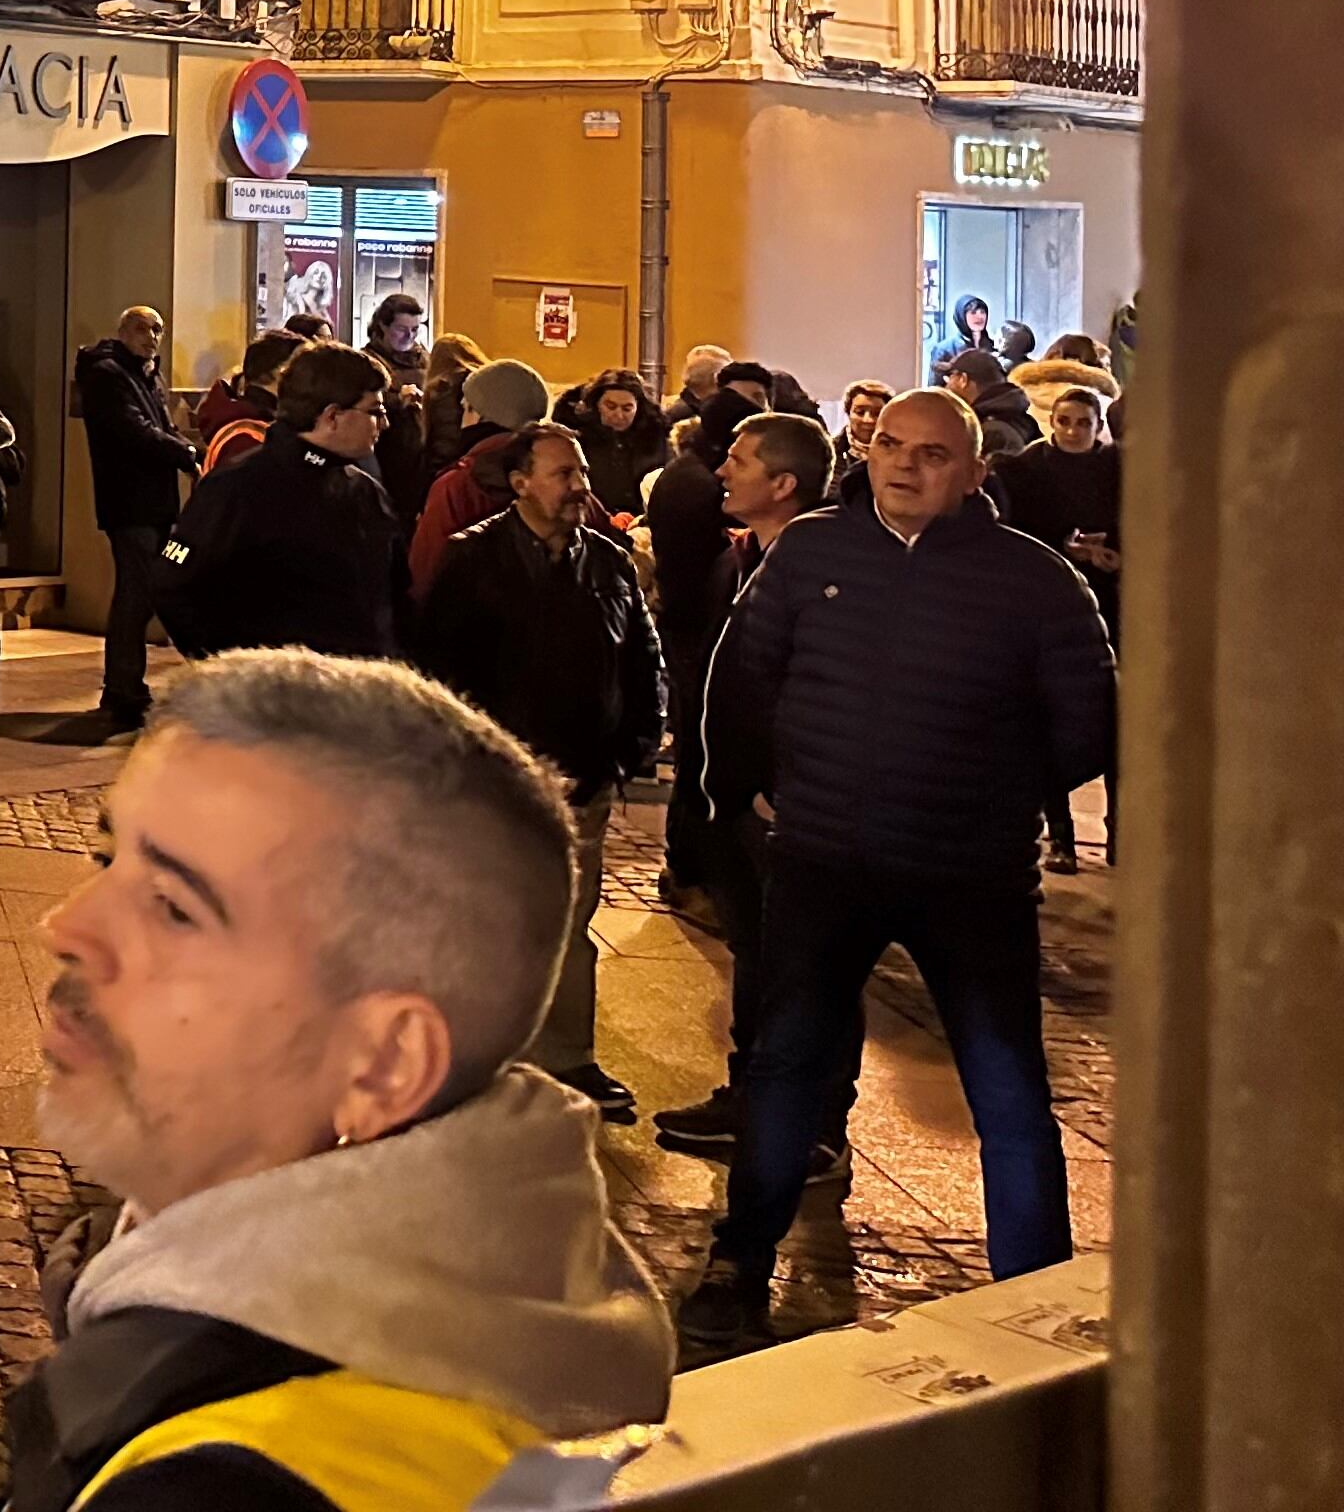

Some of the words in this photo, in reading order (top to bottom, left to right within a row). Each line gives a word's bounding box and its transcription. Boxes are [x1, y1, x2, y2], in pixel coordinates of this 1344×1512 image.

[234, 187, 256, 198] SOLO
[248, 204, 291, 215] OFICIALES
[292, 237, 338, 248] rabanne
[357, 242, 385, 253] paco
[386, 243, 433, 254] rabanne
[304, 450, 326, 467] HH
[162, 539, 190, 565] HH
